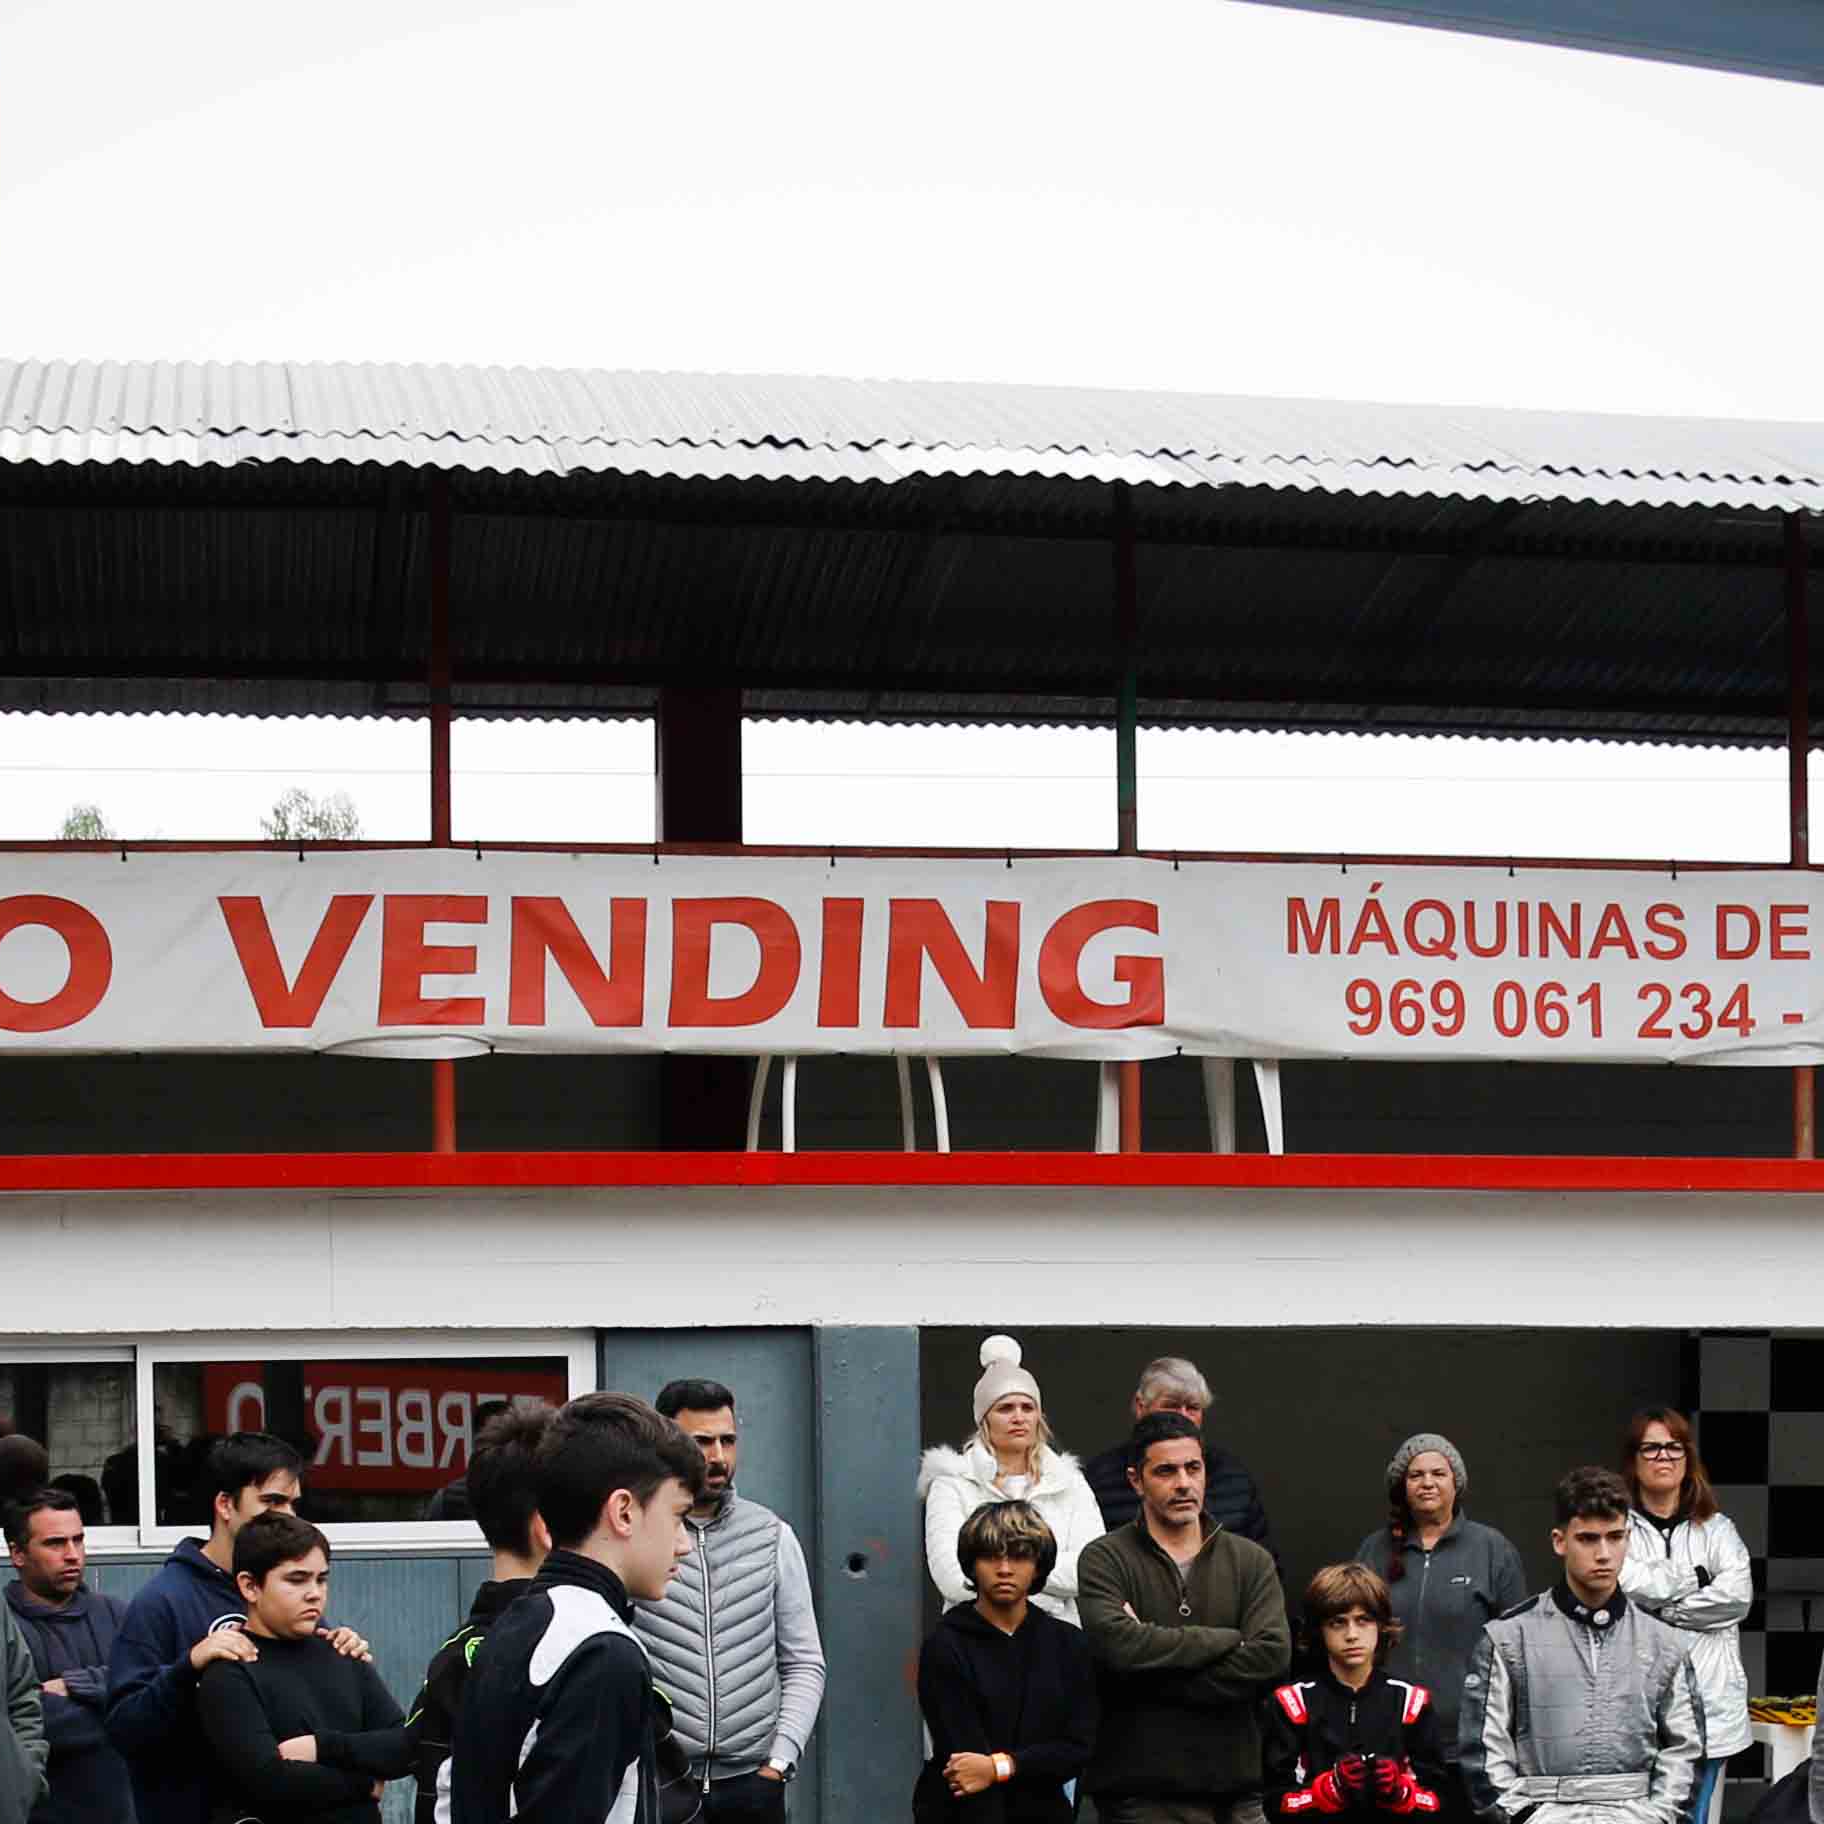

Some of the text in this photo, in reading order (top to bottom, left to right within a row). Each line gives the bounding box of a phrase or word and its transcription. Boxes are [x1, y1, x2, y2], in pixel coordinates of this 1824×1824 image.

[1286, 880, 1689, 961] MÁQUINAS
[1715, 902, 1812, 961] DE
[217, 894, 1167, 1031] VENDING
[1345, 977, 1466, 1038] 969
[1493, 980, 1603, 1040] 061
[1637, 981, 1756, 1041] 234
